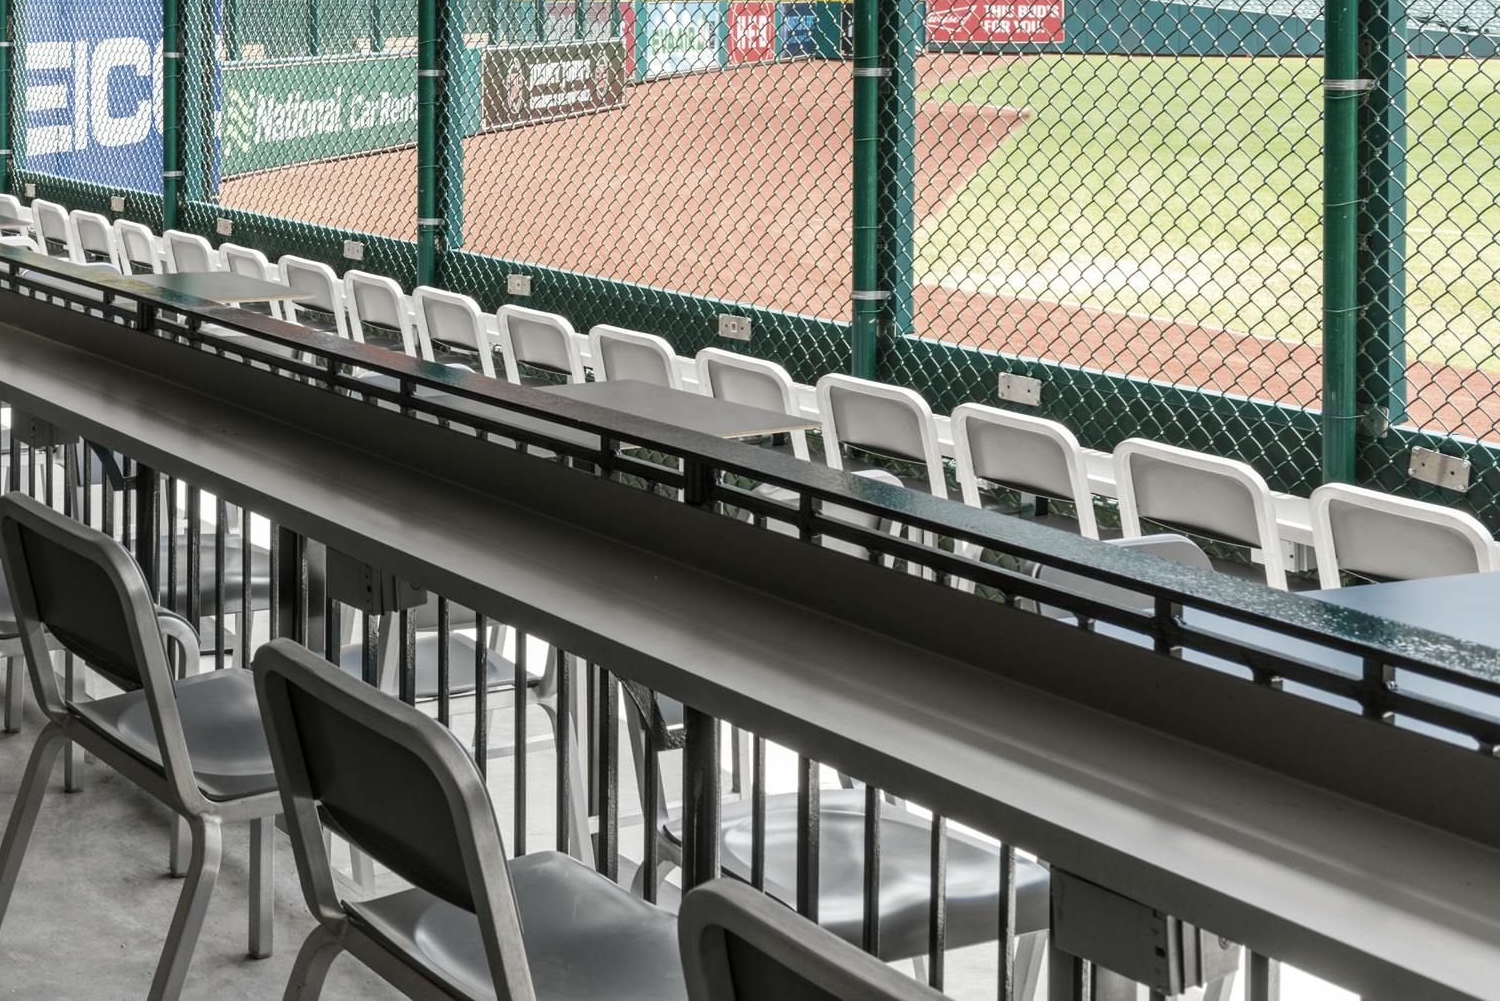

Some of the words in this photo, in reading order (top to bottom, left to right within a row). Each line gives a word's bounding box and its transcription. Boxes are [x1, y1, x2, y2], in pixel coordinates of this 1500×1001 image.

[983, 4, 1015, 18] THIS
[1017, 4, 1060, 18] BUD'S
[983, 20, 1011, 34] FOR
[254, 86, 342, 144] National
